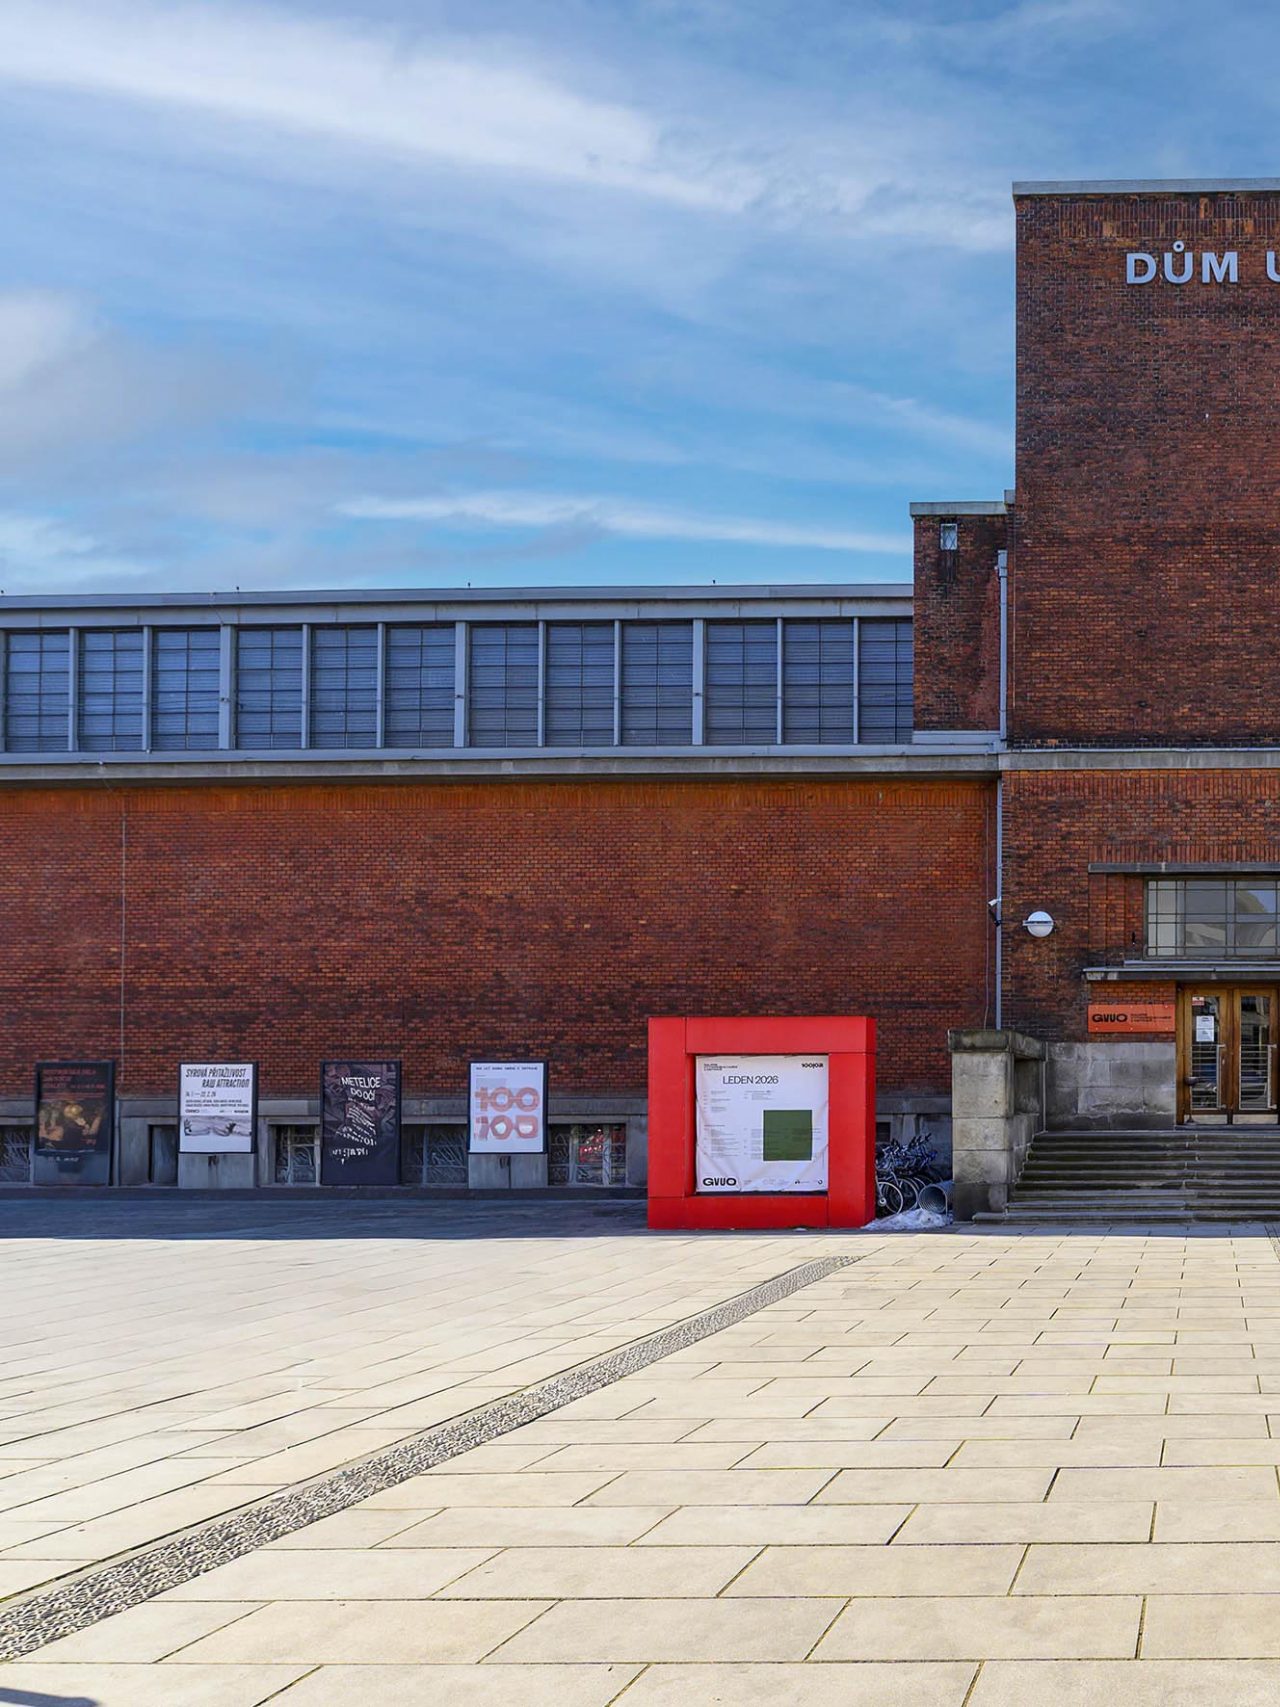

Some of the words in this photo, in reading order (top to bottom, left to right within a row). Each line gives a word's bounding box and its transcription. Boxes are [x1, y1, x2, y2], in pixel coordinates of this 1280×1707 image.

[1126, 240, 1238, 284] DŮM
[1092, 1013, 1128, 1023] GVUO
[216, 1079, 250, 1088] ATTRACTION
[341, 1077, 381, 1089] METELICE
[723, 1076, 754, 1085] LEDEN
[755, 1075, 779, 1085] 2026
[350, 1087, 362, 1098] DO
[475, 1087, 540, 1112] 100
[702, 1177, 737, 1187] GVUO
